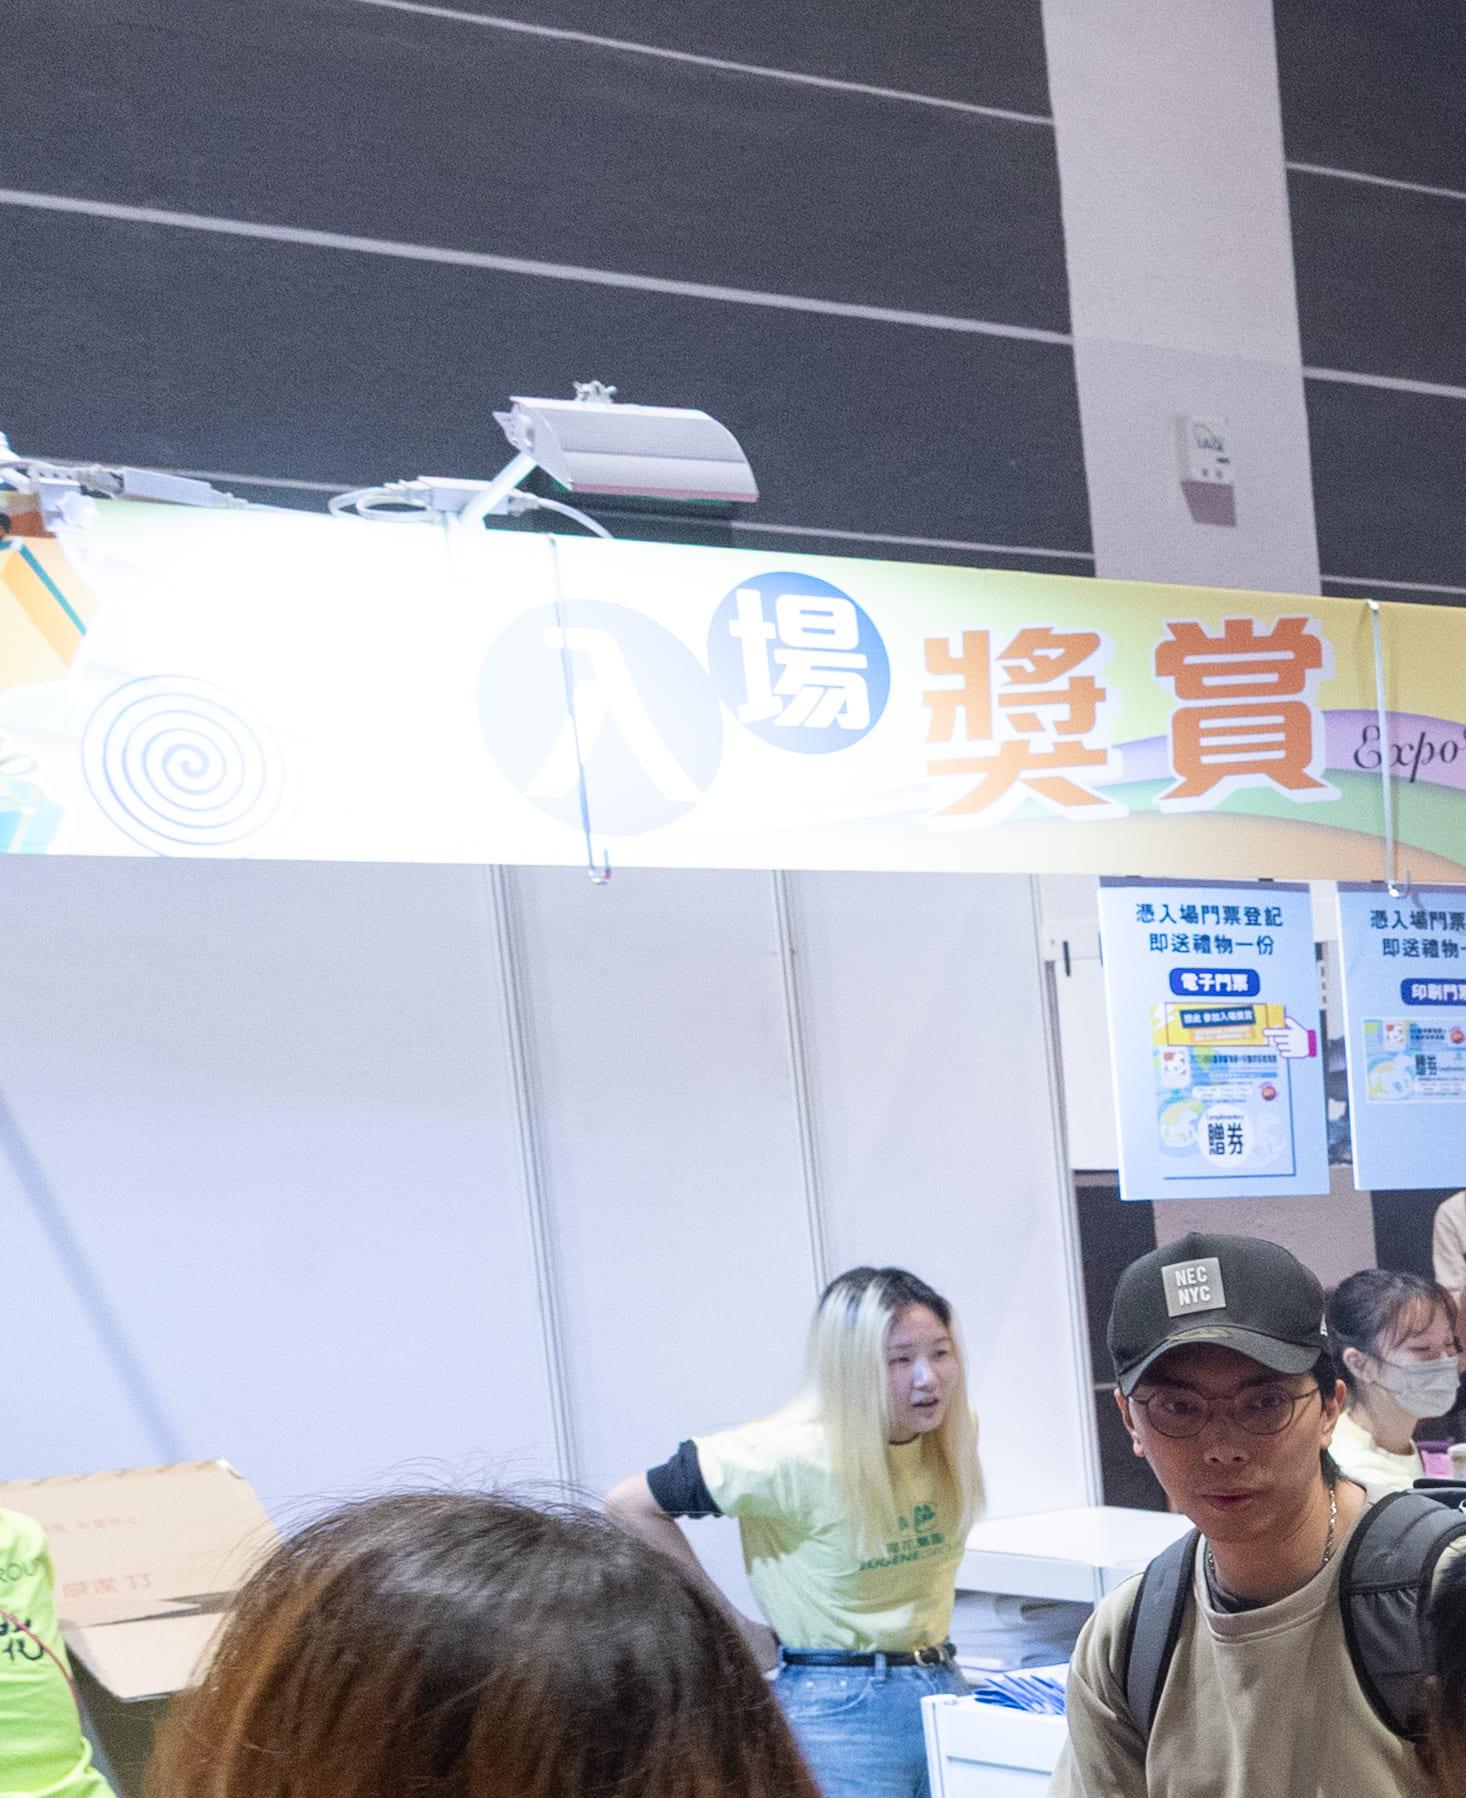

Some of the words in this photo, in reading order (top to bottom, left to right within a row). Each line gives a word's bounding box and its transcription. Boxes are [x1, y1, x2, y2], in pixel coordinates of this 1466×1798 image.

[1352, 725, 1460, 783] Expo
[1136, 903, 1284, 927] 憑入場門票登記
[1149, 932, 1276, 956] 即送禮物一份
[1180, 972, 1250, 993] 電子門票
[1174, 1266, 1209, 1287] NEC
[1177, 1285, 1211, 1305] NYC
